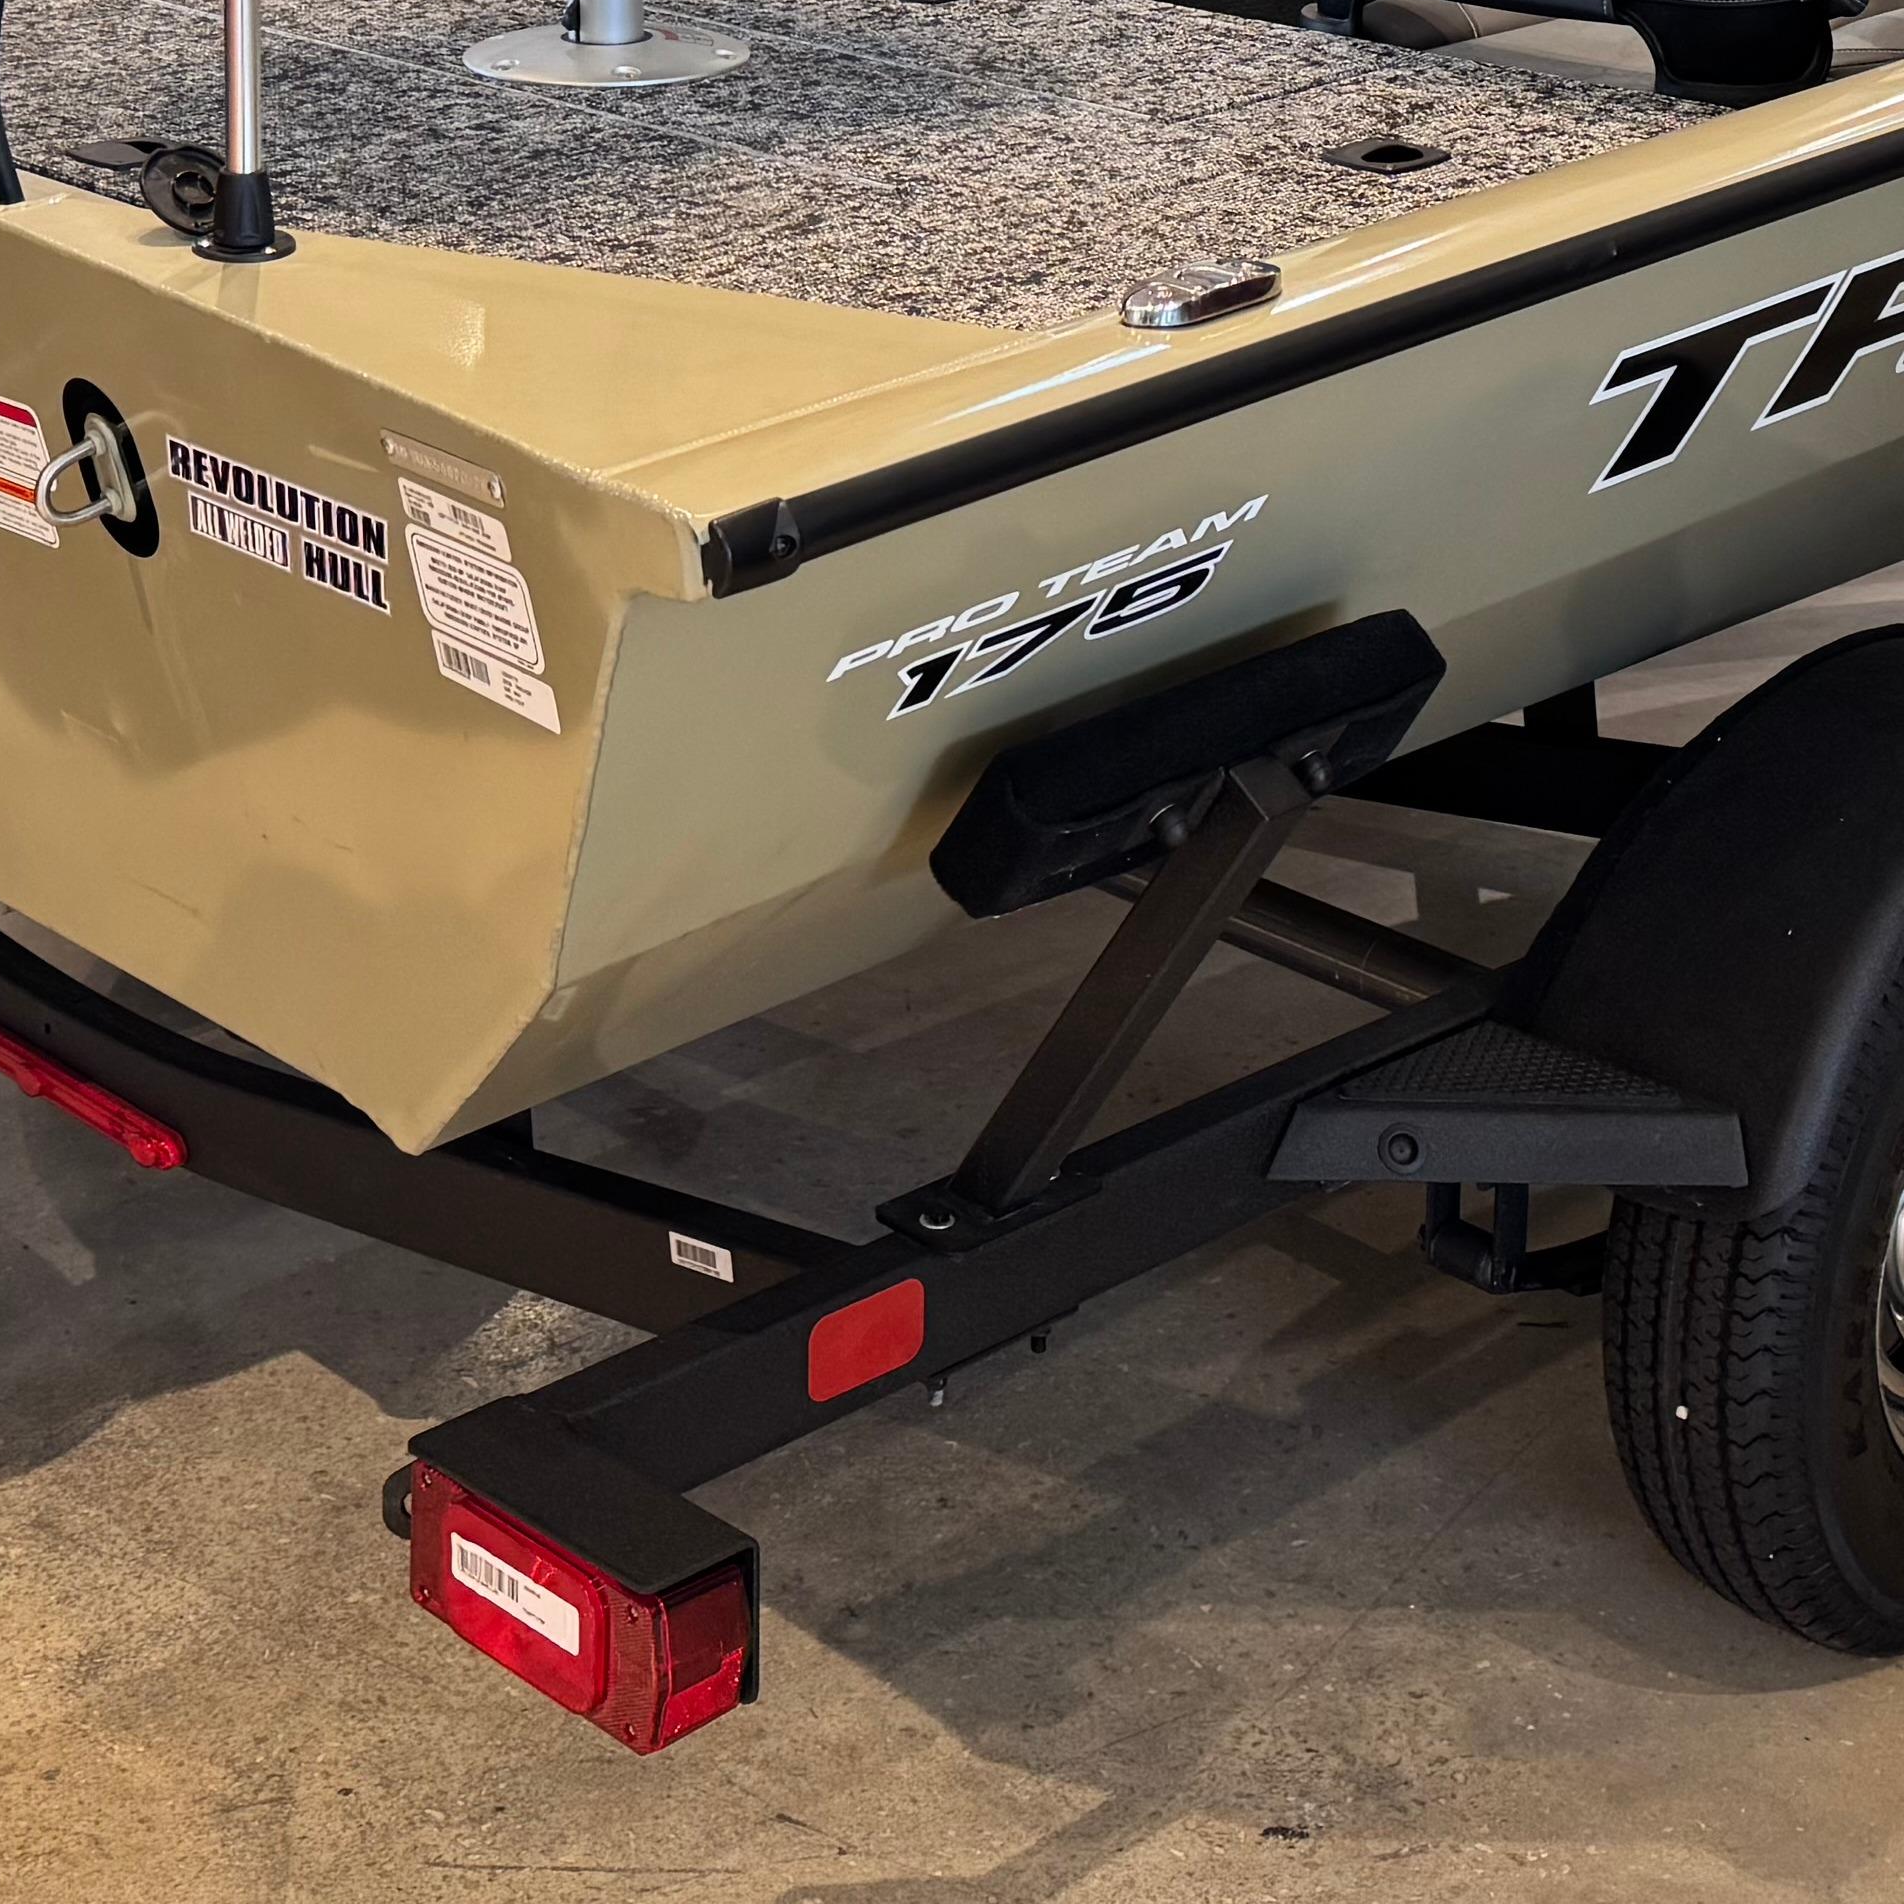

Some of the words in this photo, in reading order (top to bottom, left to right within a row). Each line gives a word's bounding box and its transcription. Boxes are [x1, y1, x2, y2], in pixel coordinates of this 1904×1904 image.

[167, 436, 387, 562] REVOLUTION
[195, 498, 222, 540] ALL
[303, 539, 389, 611] HULL
[826, 591, 1019, 682] PRO
[1038, 494, 1269, 598] TEAM
[886, 539, 1234, 720] 175
